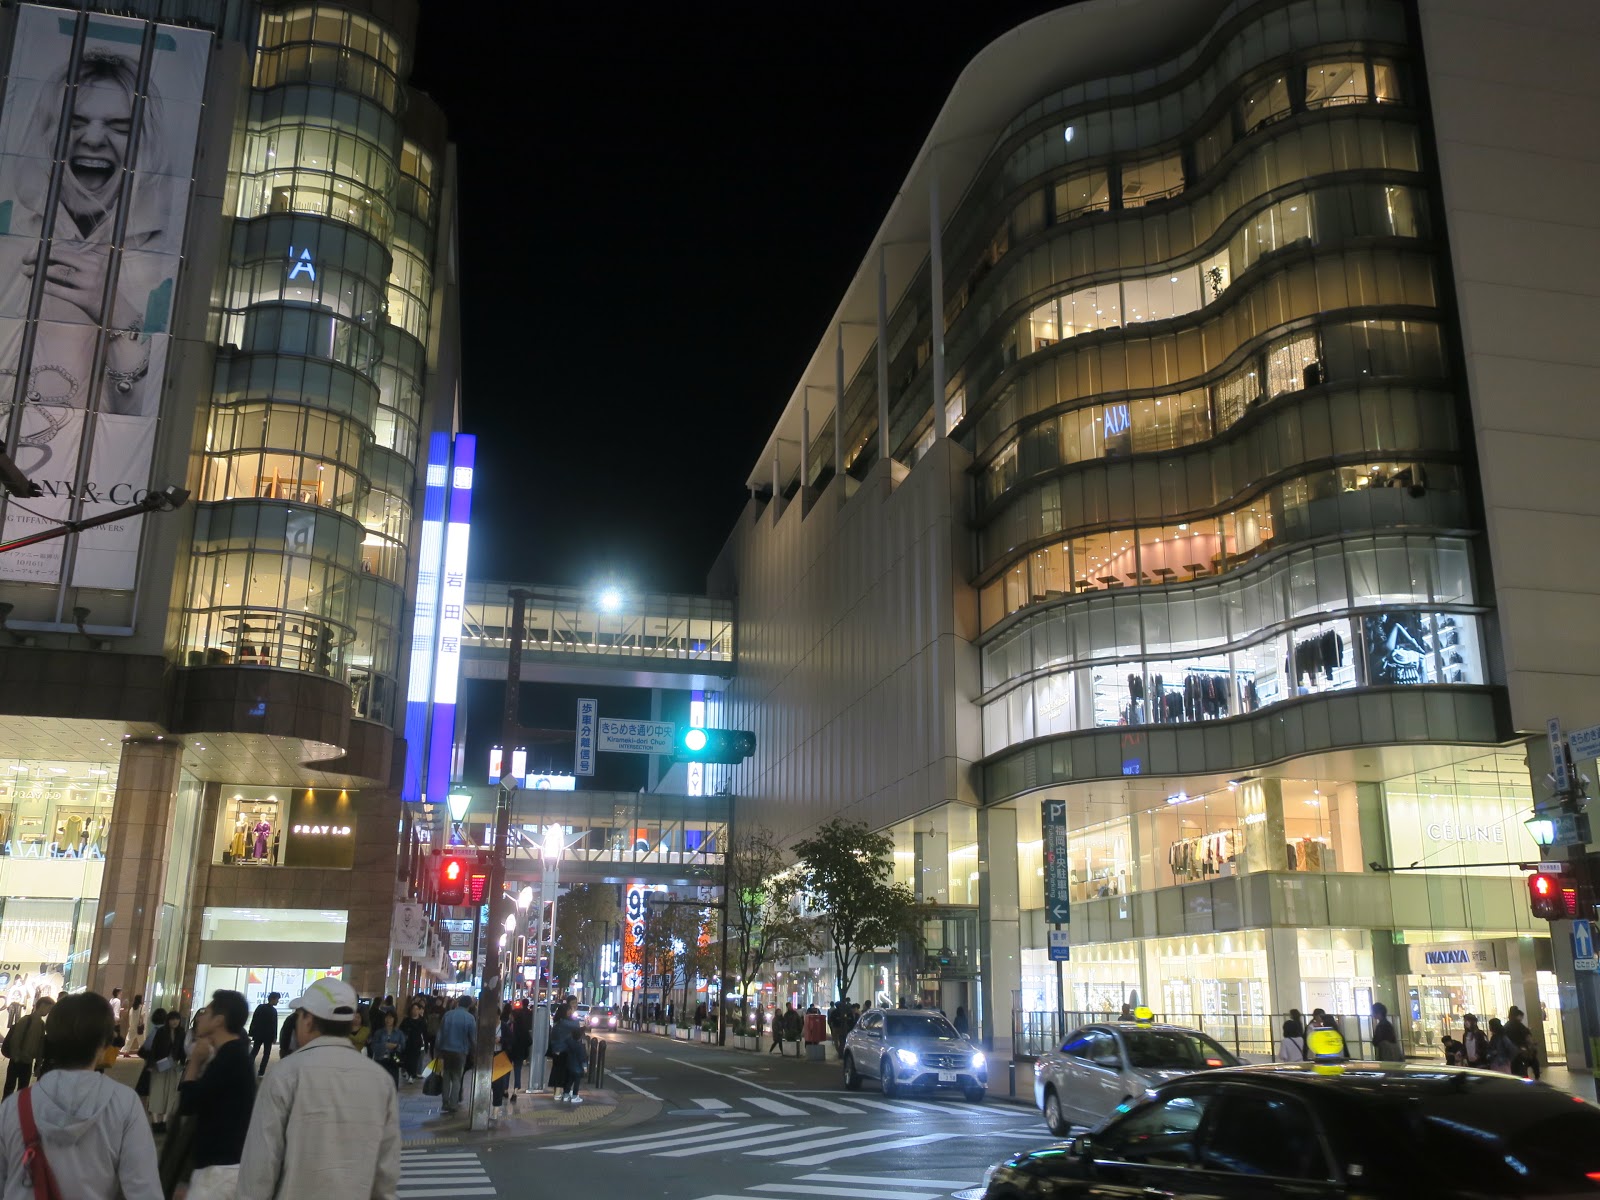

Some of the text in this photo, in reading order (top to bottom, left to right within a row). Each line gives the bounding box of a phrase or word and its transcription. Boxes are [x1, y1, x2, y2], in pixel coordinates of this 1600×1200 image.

[441, 572, 463, 653] 岩田屋
[580, 703, 592, 772] 歩車分離信号
[602, 722, 672, 738] きらめき通り中央
[607, 736, 648, 745] Kirameki-dori
[1050, 804, 1062, 821] P
[294, 824, 351, 836] FRAY I.D
[1427, 821, 1504, 843] CÉLINE
[1055, 825, 1068, 901] 福岡中央駐車場
[1425, 949, 1470, 965] IWATAYA
[1471, 950, 1487, 962] 新館
